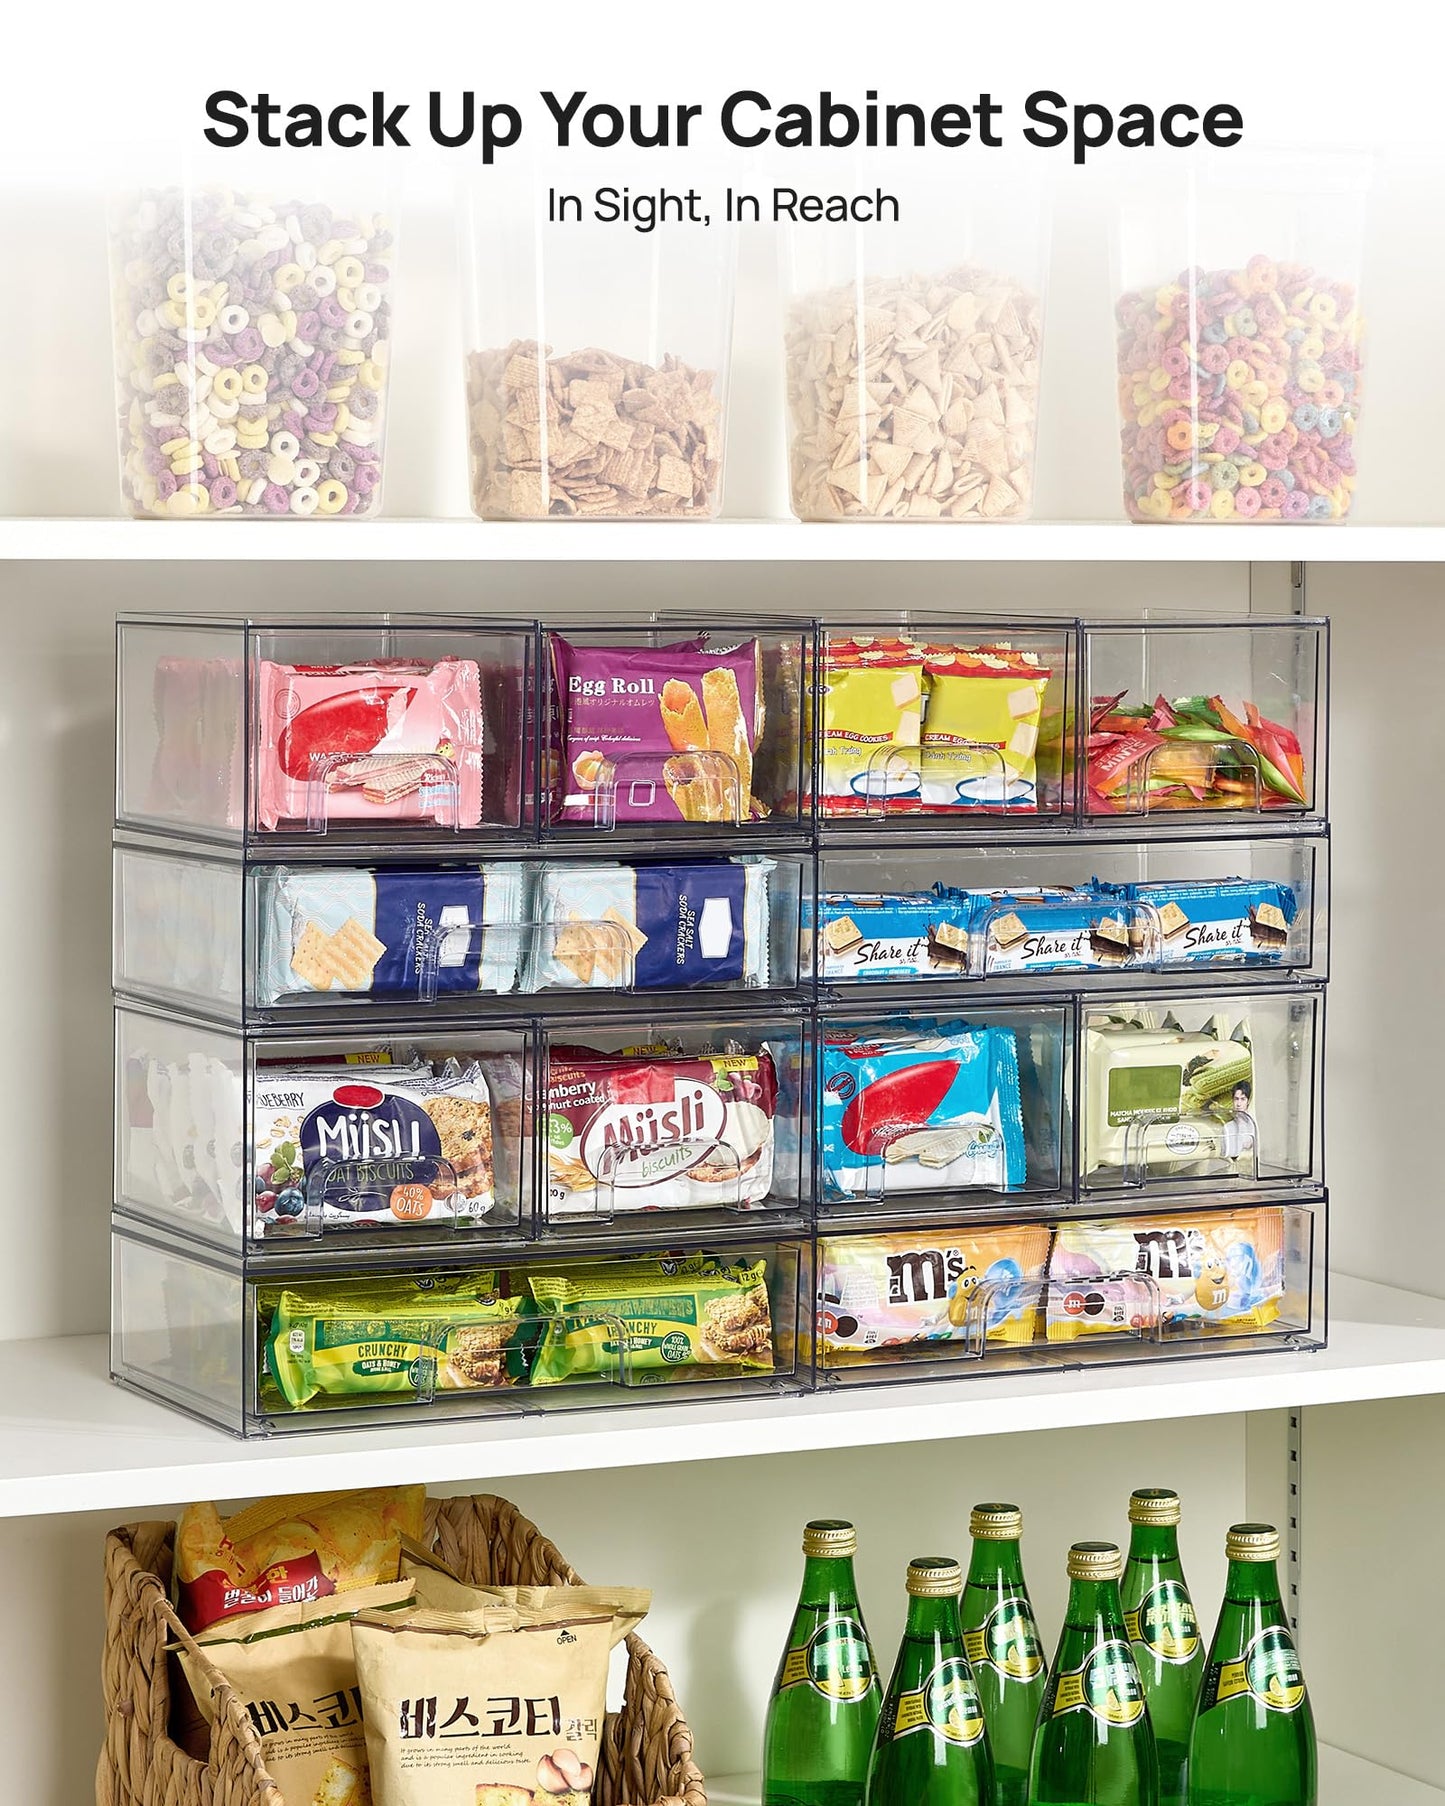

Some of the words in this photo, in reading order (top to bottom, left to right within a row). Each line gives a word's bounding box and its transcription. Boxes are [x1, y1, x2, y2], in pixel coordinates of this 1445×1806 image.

[569, 675, 606, 696] Egg
[611, 677, 655, 694] Roll
[1100, 742, 1147, 772] MINTS
[678, 894, 688, 922] SODA
[687, 910, 696, 928] SEA
[676, 920, 687, 965] CRACKERS
[685, 929, 695, 949] SALT
[1183, 927, 1228, 950] Share
[1230, 918, 1245, 939] it
[854, 941, 903, 965] Share
[906, 938, 922, 958] it
[1020, 936, 1066, 960] Share
[1070, 932, 1085, 951] it
[357, 1054, 380, 1064] NEW
[723, 1058, 748, 1068] NEW
[641, 1146, 693, 1178] biscuits
[402, 1187, 425, 1201] 40%
[396, 1199, 425, 1216] OATS
[358, 1344, 408, 1358] CRUNCHY
[362, 1360, 376, 1370] OATS
[556, 1634, 578, 1646] OPEN
[400, 1696, 560, 1739] 비스코티
